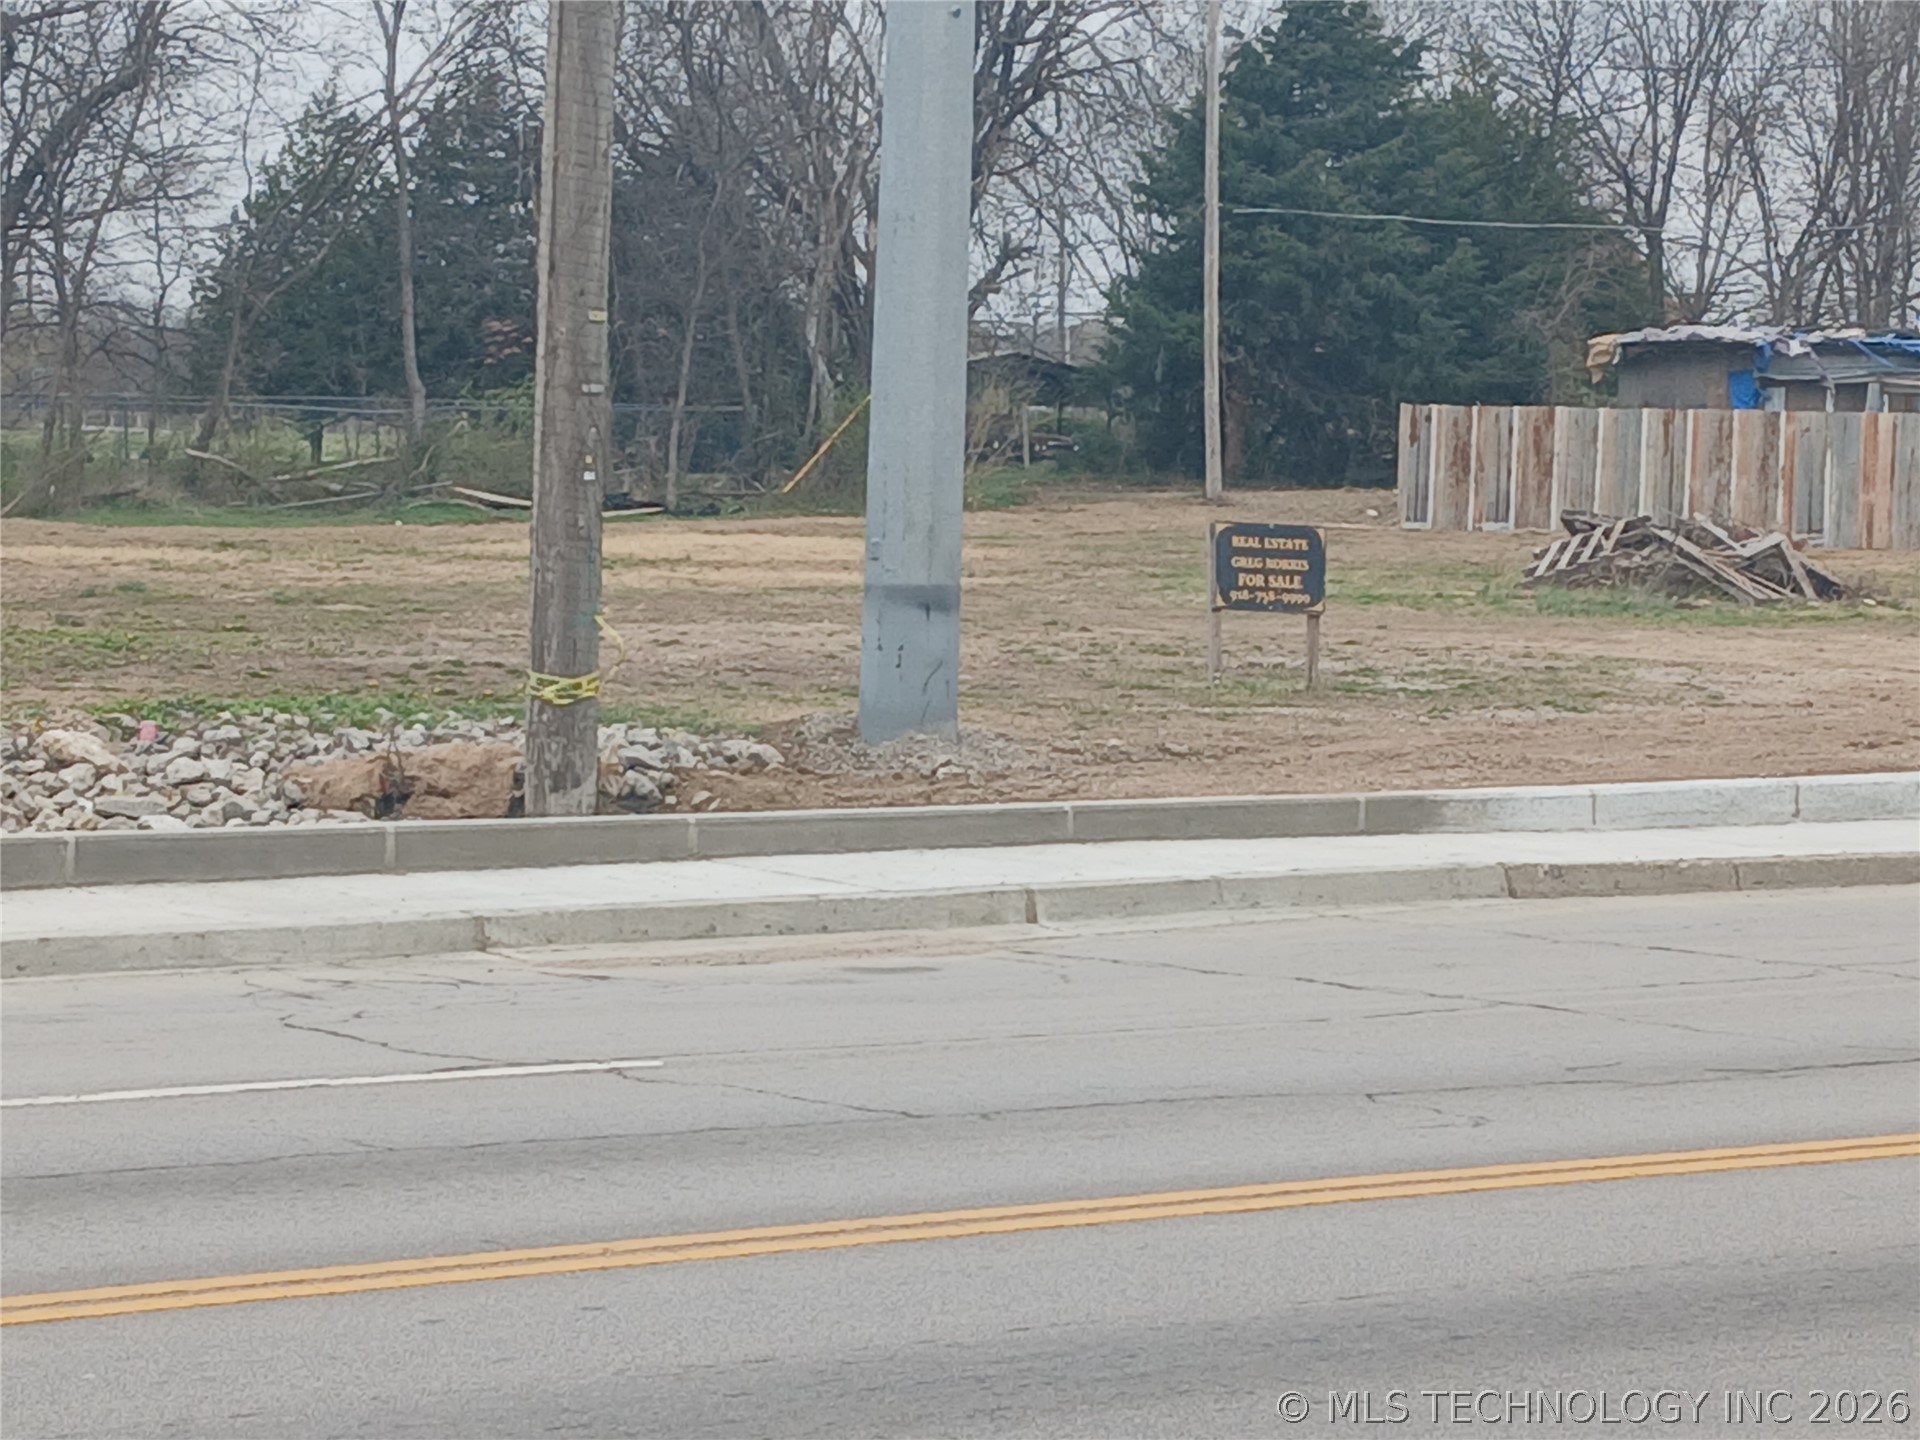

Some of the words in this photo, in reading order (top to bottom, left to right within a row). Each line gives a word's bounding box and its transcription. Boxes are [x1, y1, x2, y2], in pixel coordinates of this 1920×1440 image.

[1231, 535, 1262, 548] REAL
[1264, 537, 1309, 551] ESTATE
[1238, 573, 1265, 587] FOR
[1268, 575, 1304, 589] SALE
